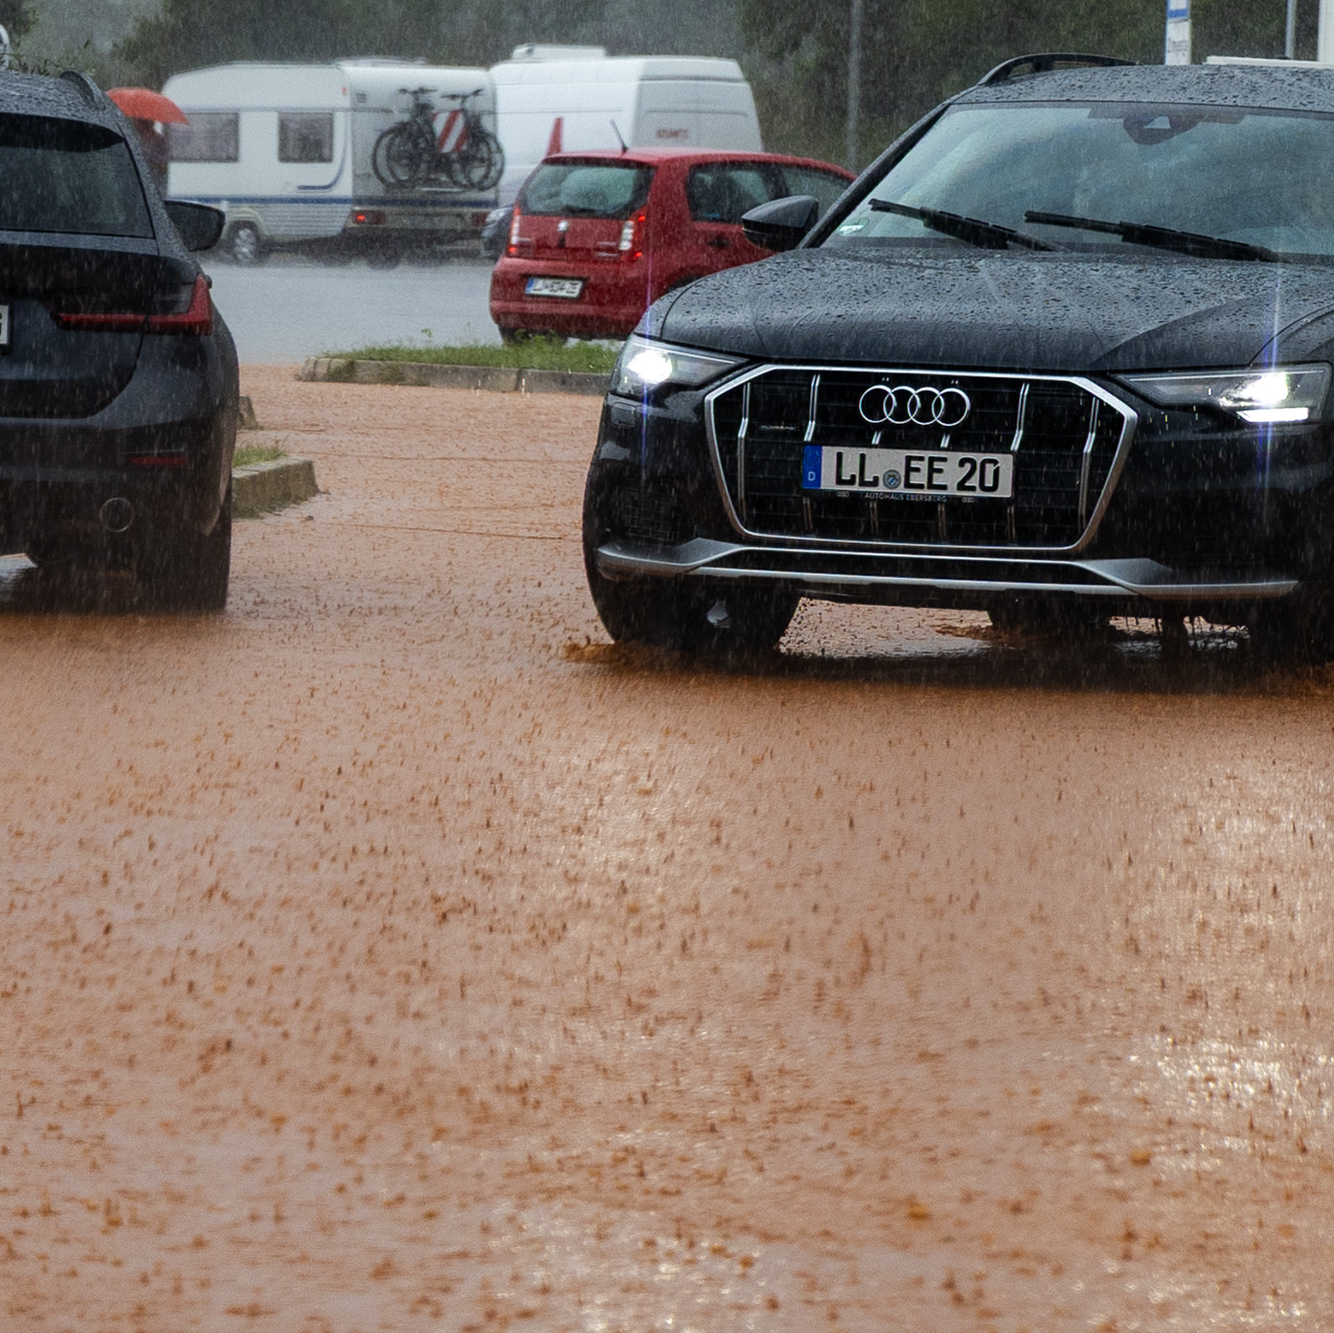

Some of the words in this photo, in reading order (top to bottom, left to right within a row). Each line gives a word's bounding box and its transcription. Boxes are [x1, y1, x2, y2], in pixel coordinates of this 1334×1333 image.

[808, 471, 816, 481] D
[835, 451, 879, 487] LL
[904, 455, 948, 491] EE
[956, 457, 1000, 492] 20
[865, 492, 904, 501] AUTOHAUS
